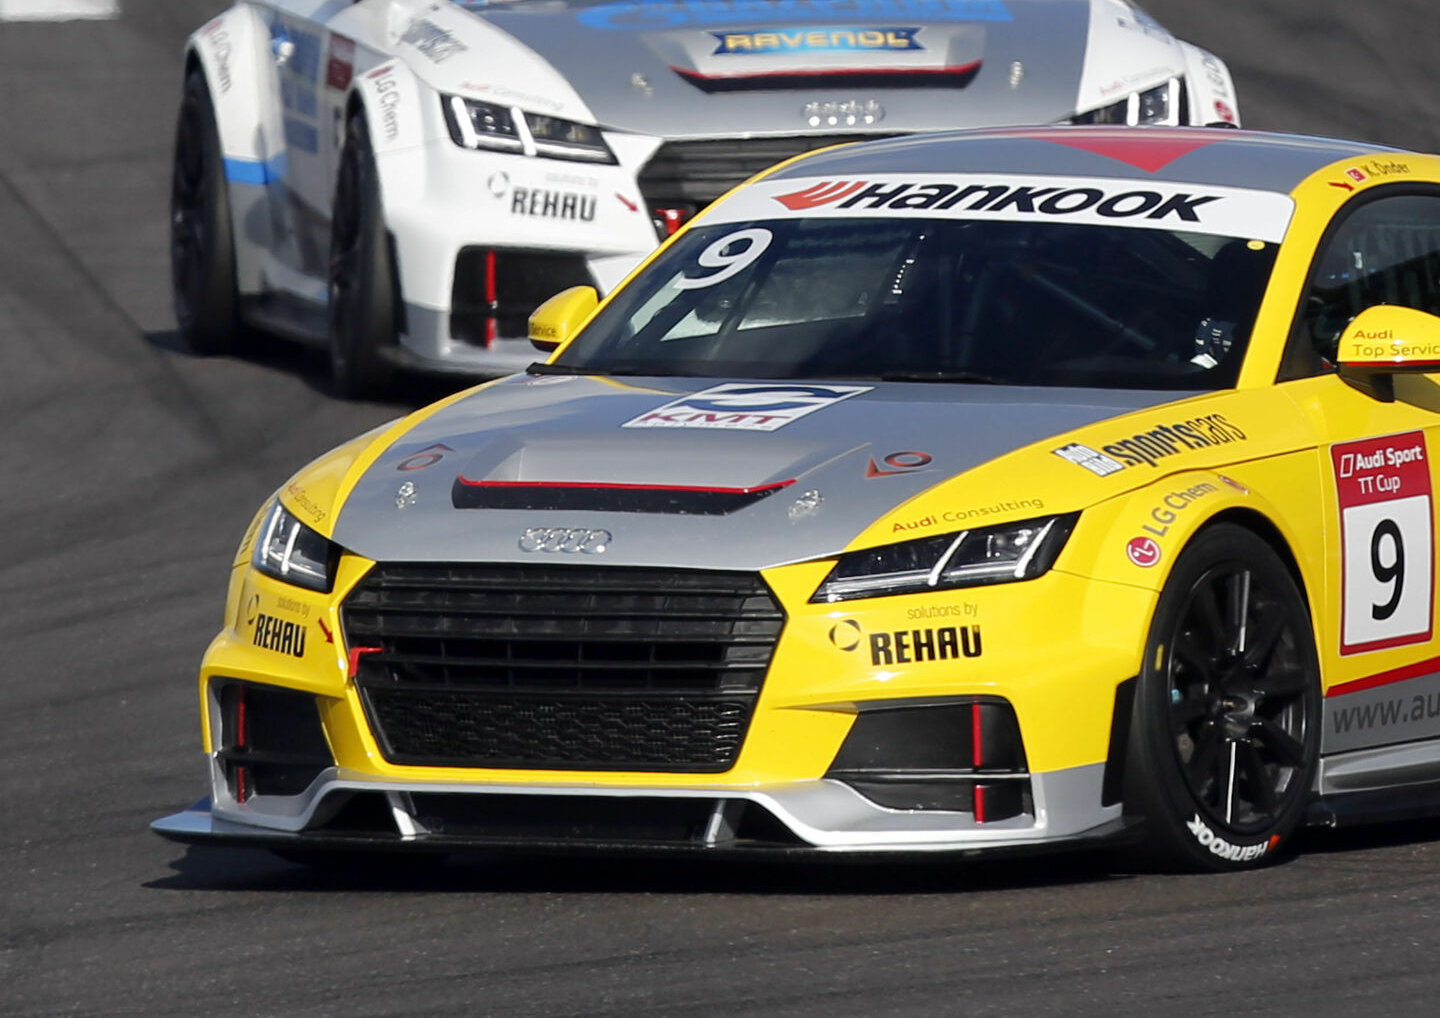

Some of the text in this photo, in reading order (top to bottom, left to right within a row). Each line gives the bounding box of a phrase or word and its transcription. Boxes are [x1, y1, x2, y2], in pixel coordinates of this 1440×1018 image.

[724, 31, 910, 52] RAVENOL
[512, 187, 598, 222] REHAU
[675, 226, 773, 291] 9
[1353, 329, 1394, 340] Audi
[1352, 344, 1385, 358] Top
[640, 412, 792, 425] KMT
[1356, 445, 1424, 470] Audi Sport
[1357, 475, 1401, 495] TT Cup
[892, 497, 1045, 534] Audi Consulting
[1142, 481, 1219, 537] LG Chem
[1370, 518, 1405, 621] 9
[907, 602, 978, 620] solutions by
[253, 613, 308, 659] REHAU
[869, 624, 983, 667] REHAU
